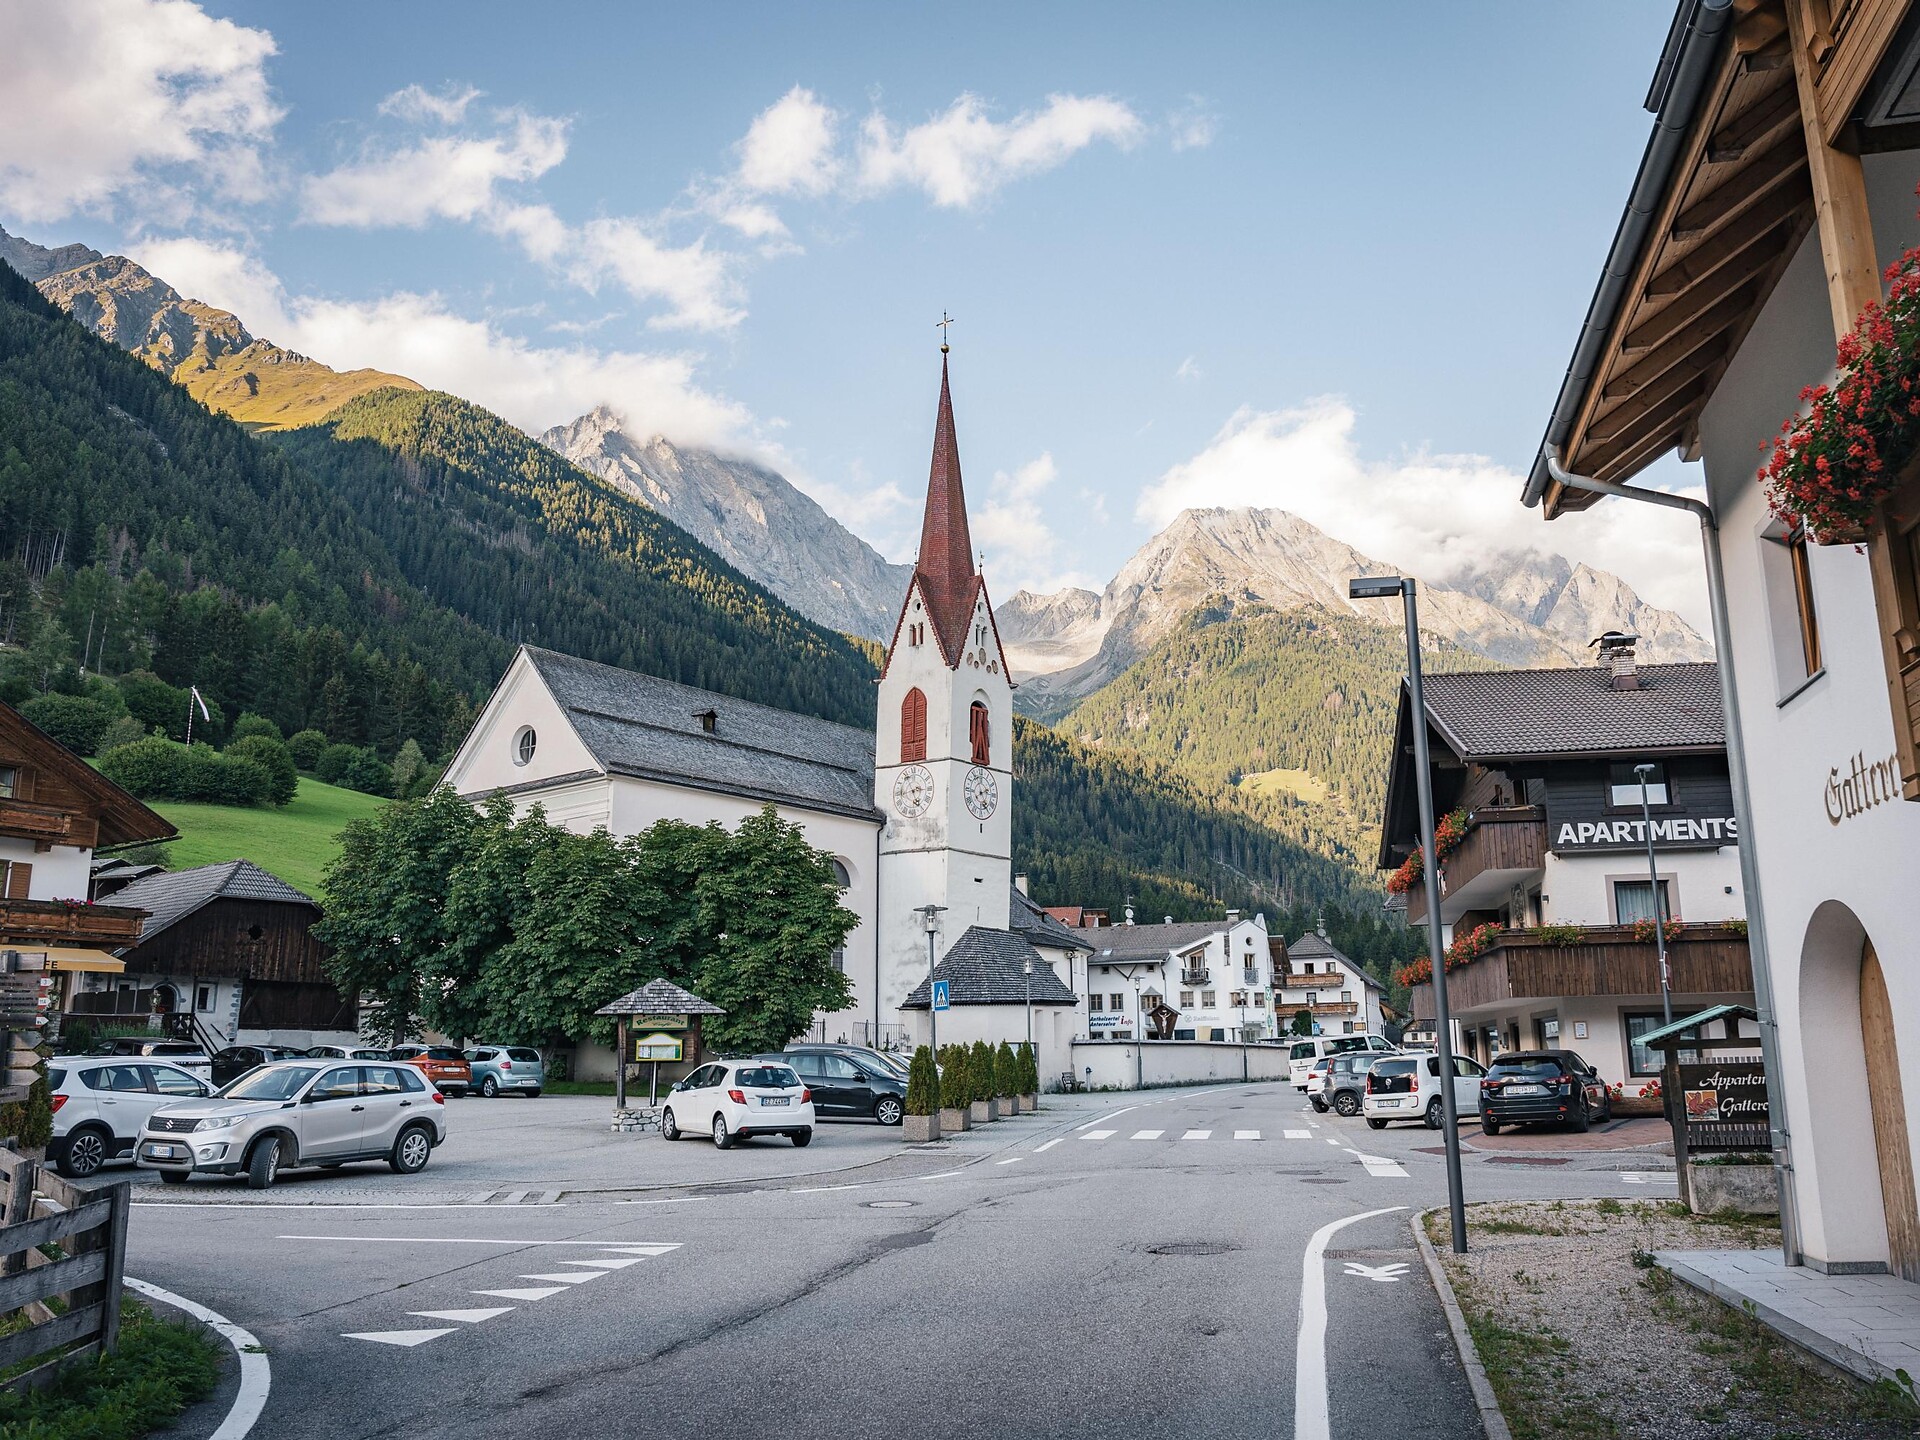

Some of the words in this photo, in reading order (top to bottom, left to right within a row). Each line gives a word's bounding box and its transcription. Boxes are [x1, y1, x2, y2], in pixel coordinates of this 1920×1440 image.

[1557, 817, 1739, 844] APARTMENTS
[636, 1015, 685, 1026] Restaurant
[1120, 1015, 1134, 1026] info
